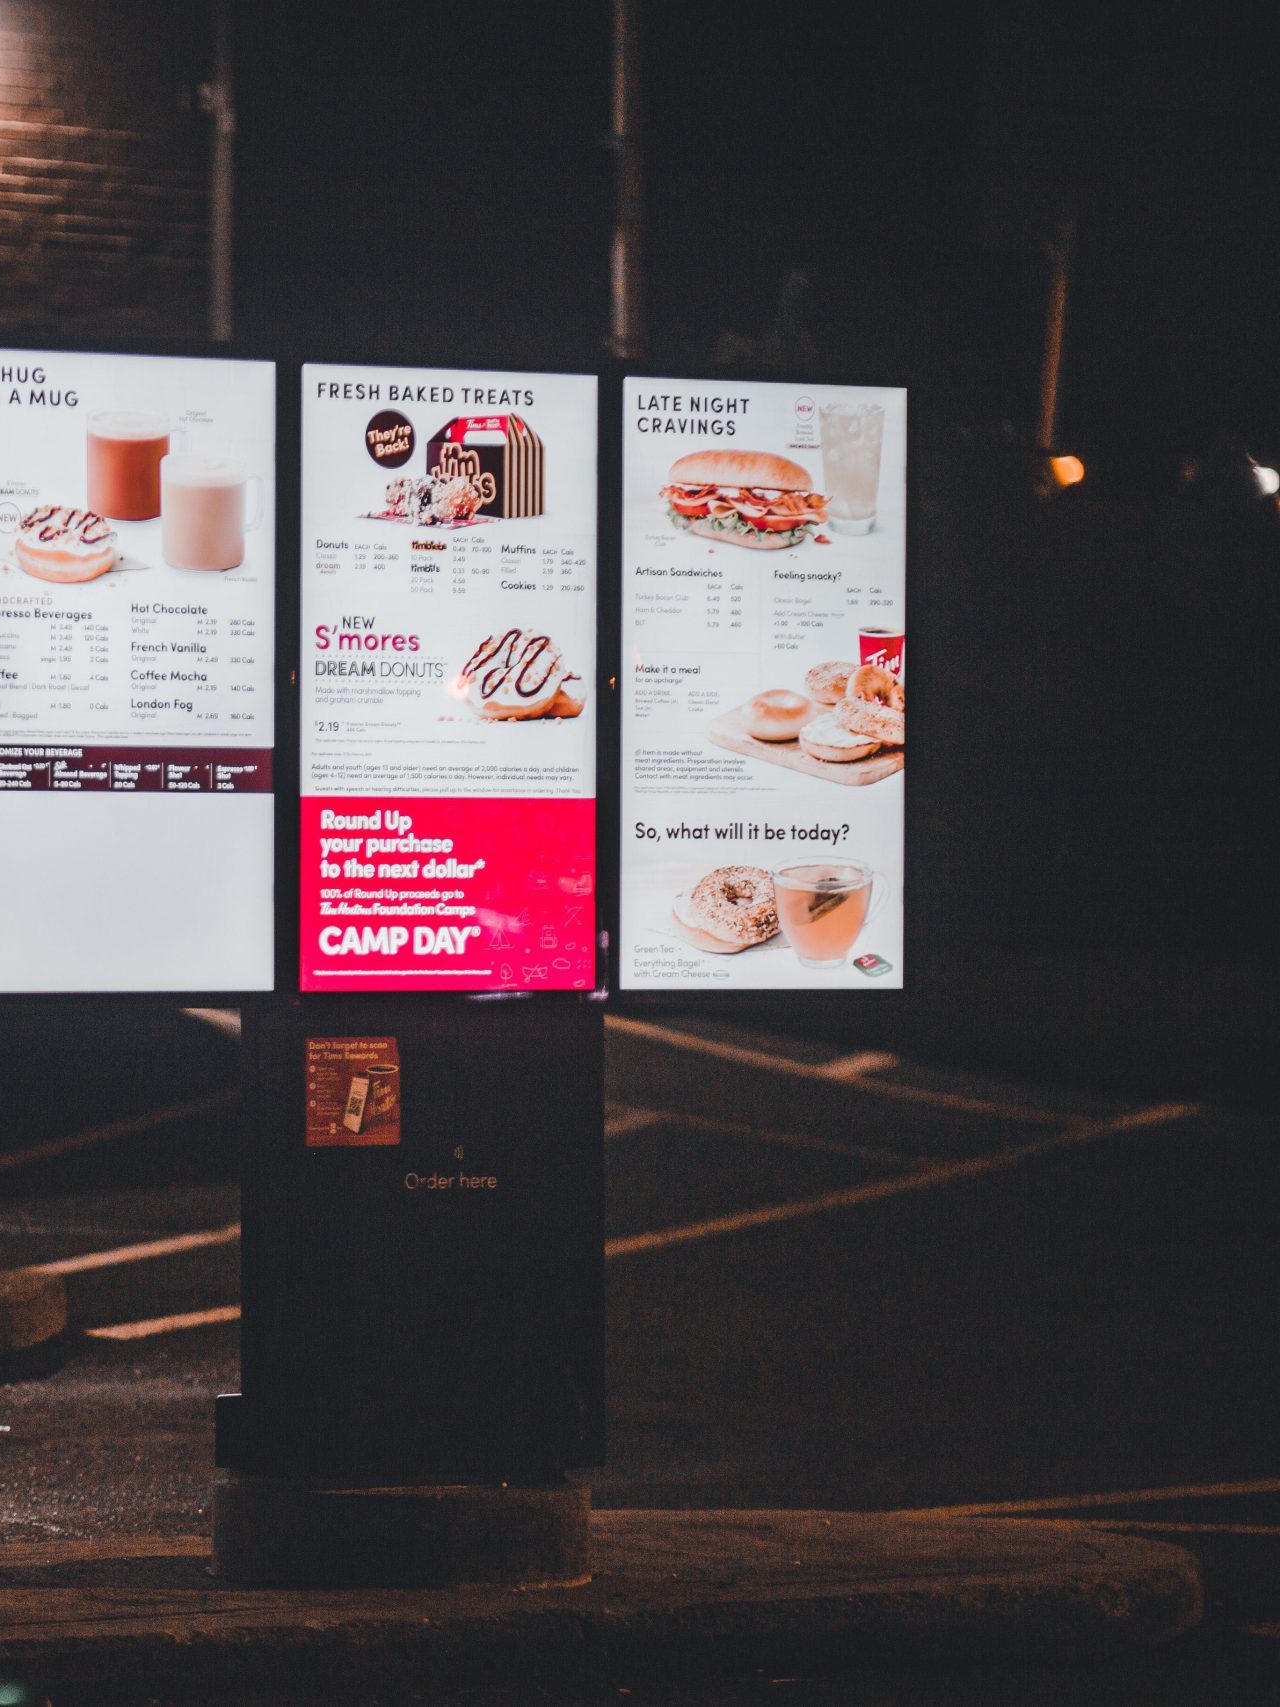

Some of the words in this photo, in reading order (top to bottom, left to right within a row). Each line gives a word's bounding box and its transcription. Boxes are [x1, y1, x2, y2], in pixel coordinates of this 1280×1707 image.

[1, 366, 46, 384] HUG
[9, 388, 22, 405] A
[29, 390, 80, 407] MUG
[317, 382, 380, 400] FRESH
[389, 385, 454, 403] BAKED
[461, 388, 535, 406] TREATS
[637, 394, 682, 412] LATE
[690, 397, 750, 414] NIGHT
[637, 417, 737, 436] CRAVINGS
[367, 424, 412, 444] They're
[374, 439, 410, 458] Back!
[316, 539, 349, 549] Donuts
[501, 544, 537, 554] Muffins
[316, 561, 340, 569] dream
[635, 566, 668, 576] Artisan
[670, 567, 724, 578] Sandwiches
[774, 570, 806, 582] Feeling
[807, 571, 842, 583] snacky?
[501, 580, 537, 590] Cookies
[34, 608, 93, 622] Beverages
[131, 603, 150, 613] Hot
[153, 603, 208, 614] Chocolate
[342, 616, 376, 630] NEW
[315, 624, 420, 652] S'mores
[131, 642, 167, 652] French
[171, 642, 206, 653] Vanilla
[315, 661, 376, 676] DREAM
[635, 664, 660, 674] Make
[662, 665, 669, 674] it
[679, 664, 701, 675] meal
[131, 670, 167, 681] Coffee
[170, 670, 207, 682] Mocha
[315, 686, 335, 694] Made
[337, 686, 350, 694] with
[351, 687, 395, 695] marshmallow
[397, 688, 421, 698] topping
[131, 698, 170, 709] London
[174, 699, 193, 712] Fog
[330, 697, 356, 705] graham
[358, 696, 384, 704] crumble
[24, 748, 44, 758] YOUR
[45, 748, 83, 758] BEVERAGE
[312, 763, 331, 771] Adults
[320, 809, 382, 830] Round
[384, 810, 413, 835] Up
[635, 821, 662, 842] So,
[666, 822, 710, 840] what
[714, 822, 744, 840] will
[748, 823, 760, 840] it
[764, 823, 785, 841] be
[791, 824, 850, 845] today?
[320, 837, 364, 857] your
[366, 833, 454, 858] purchase
[320, 861, 341, 879] to
[344, 858, 375, 879] the
[377, 861, 420, 879] next
[320, 888, 343, 899] 100%
[343, 888, 355, 899] of
[355, 888, 384, 899] Round
[385, 888, 399, 901] Up
[400, 888, 441, 901] proceeds
[441, 890, 454, 901] go
[454, 888, 465, 899] to
[373, 902, 435, 915] Foundation
[436, 902, 476, 918] Camps
[318, 926, 409, 956] CAMP
[634, 945, 658, 954] Green
[660, 945, 674, 954] Tea
[634, 959, 675, 969] Everything
[677, 959, 700, 970] Bagel
[634, 970, 650, 978] with
[652, 970, 680, 978] Cream
[681, 970, 711, 979] Cheese
[404, 1172, 455, 1190] Order
[458, 1171, 497, 1189] here
